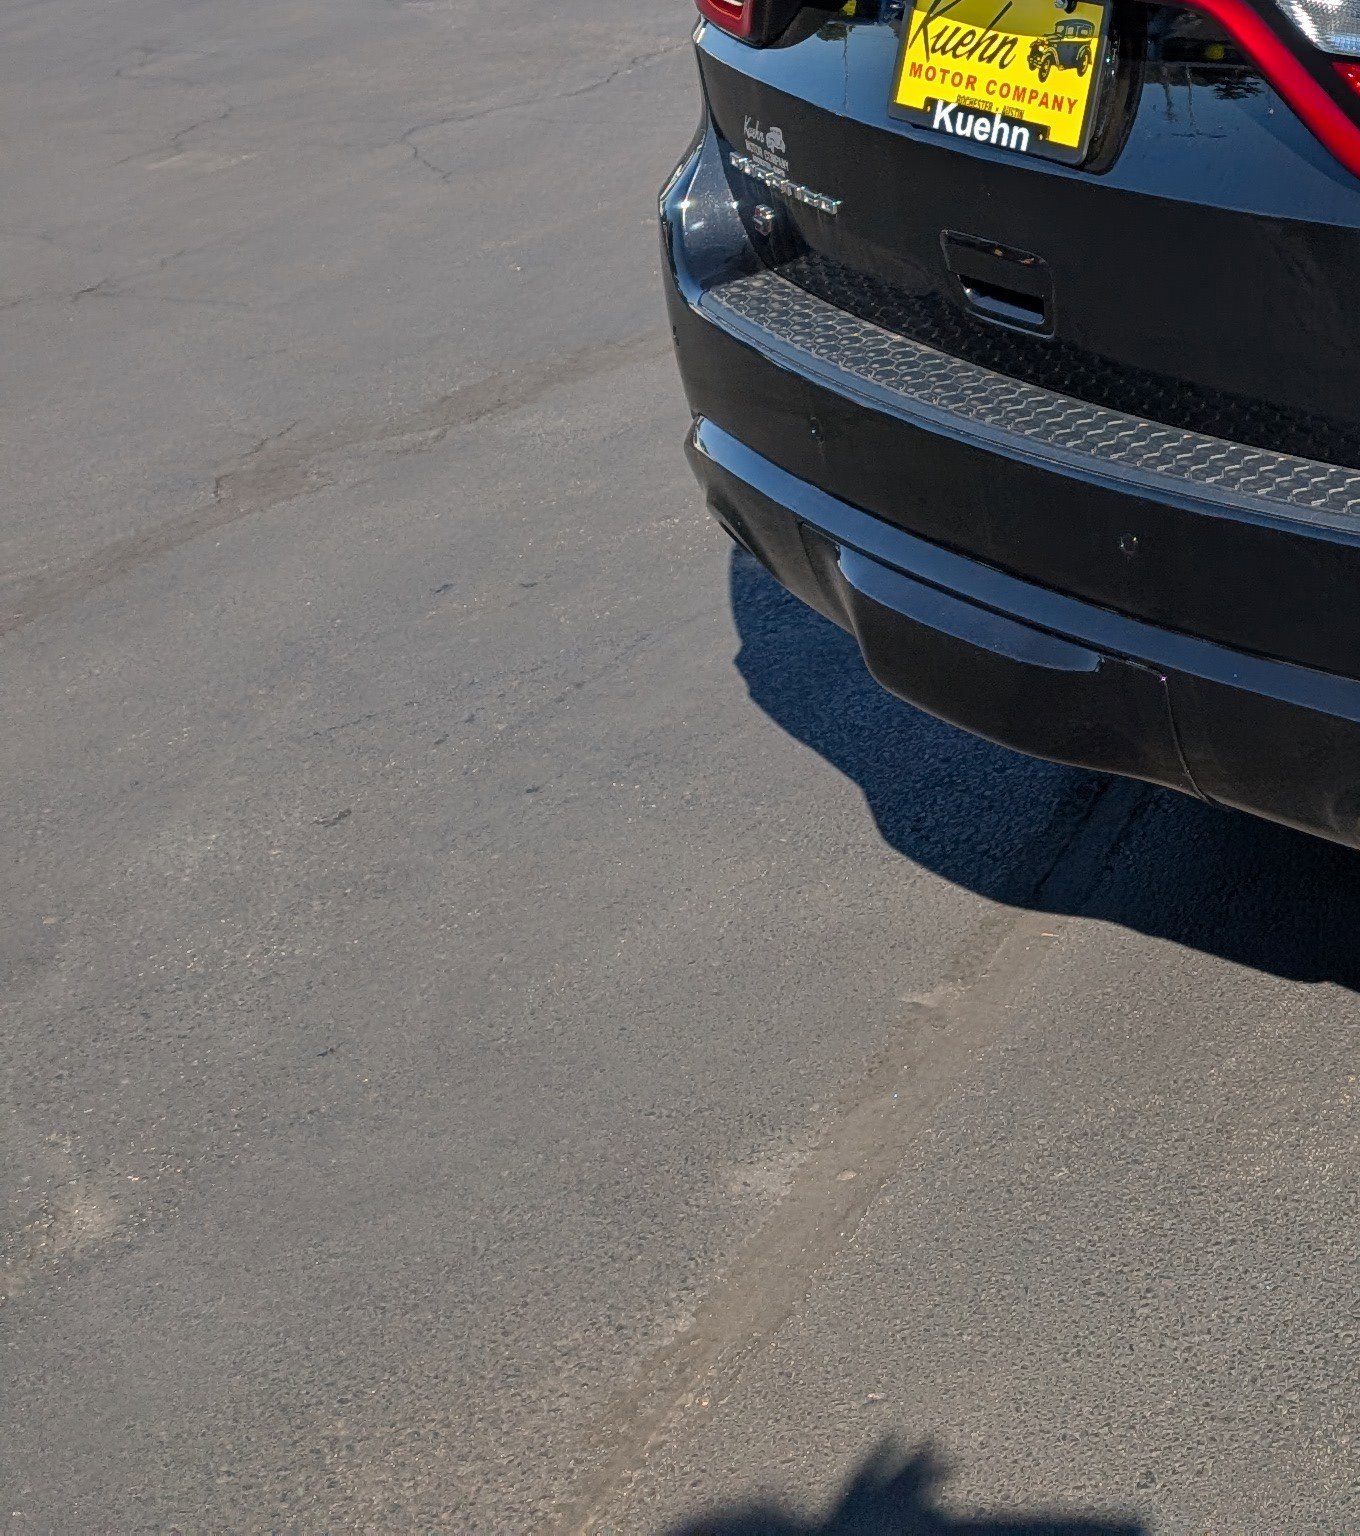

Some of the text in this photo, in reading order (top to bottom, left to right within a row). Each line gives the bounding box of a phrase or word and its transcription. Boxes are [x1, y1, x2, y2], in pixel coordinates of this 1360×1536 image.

[909, 61, 1079, 115] MOTOR COMPANY
[932, 100, 1030, 152] Kuehn
